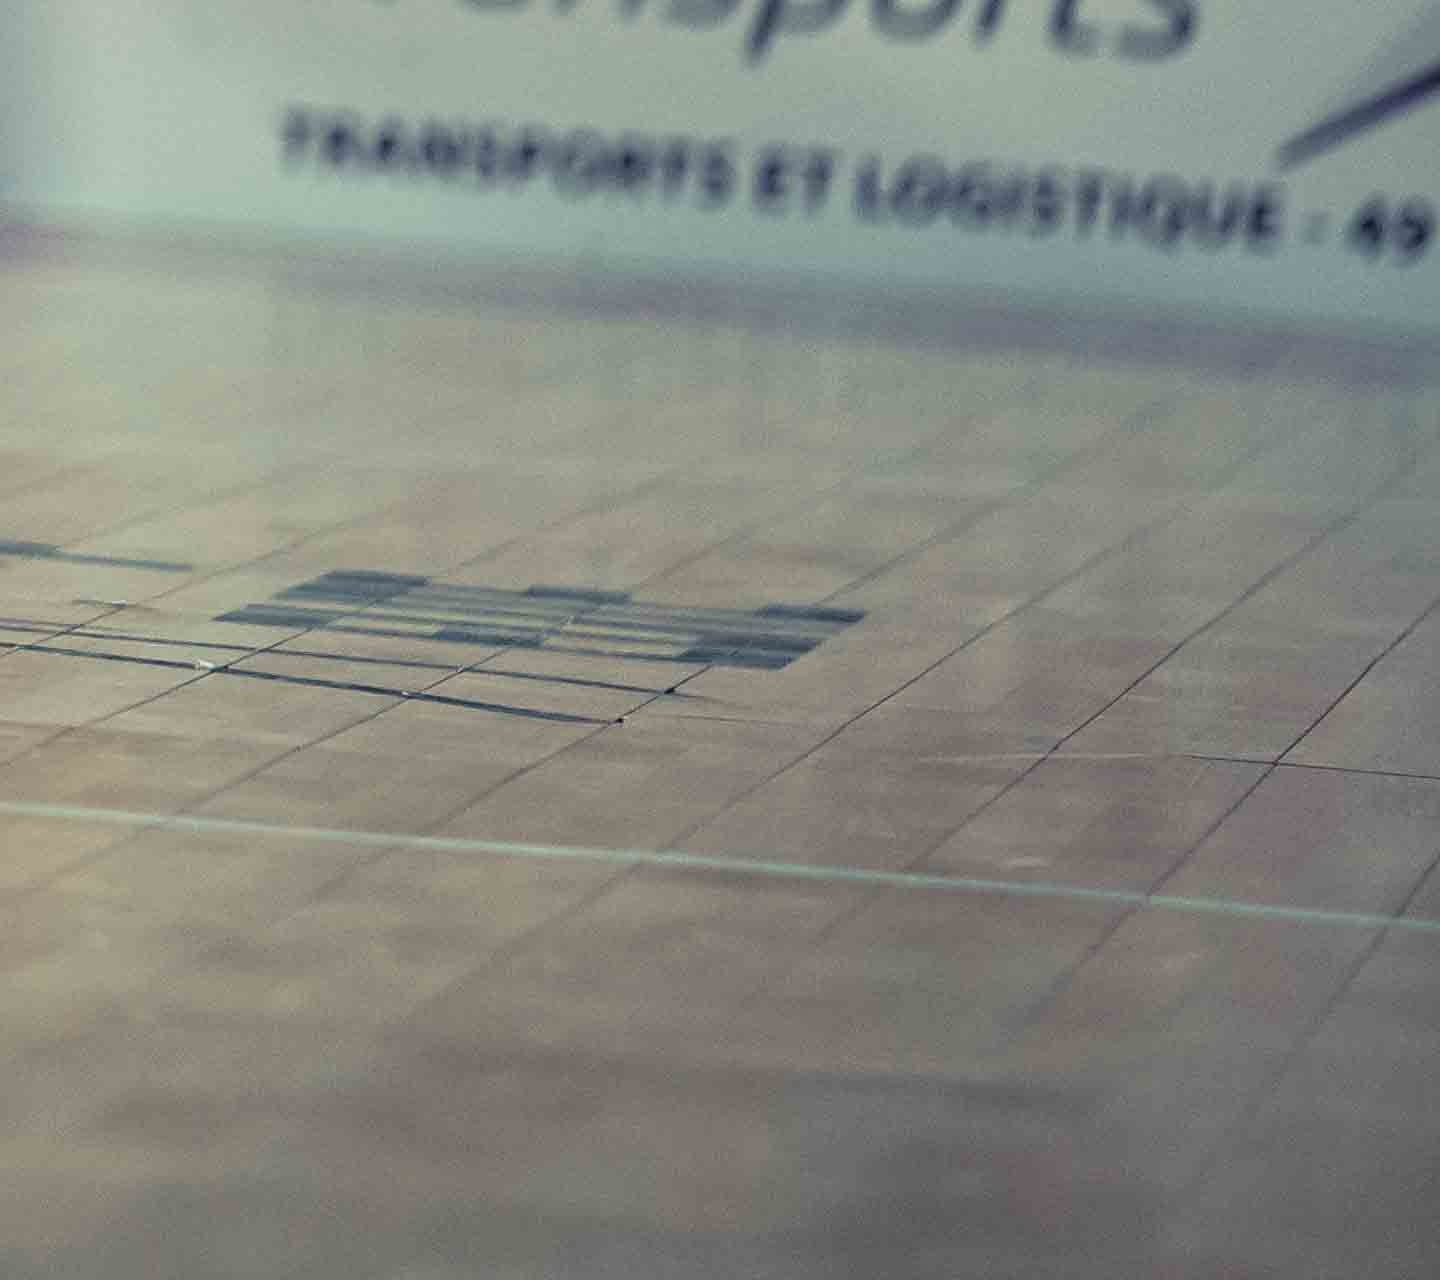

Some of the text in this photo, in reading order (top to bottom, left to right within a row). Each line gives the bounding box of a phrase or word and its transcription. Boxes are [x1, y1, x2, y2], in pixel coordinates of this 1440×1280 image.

[280, 102, 742, 216] TRANSPORTS
[752, 140, 838, 220] ET
[852, 152, 1285, 257] LOGISTIQUE
[1345, 192, 1437, 270] 49
